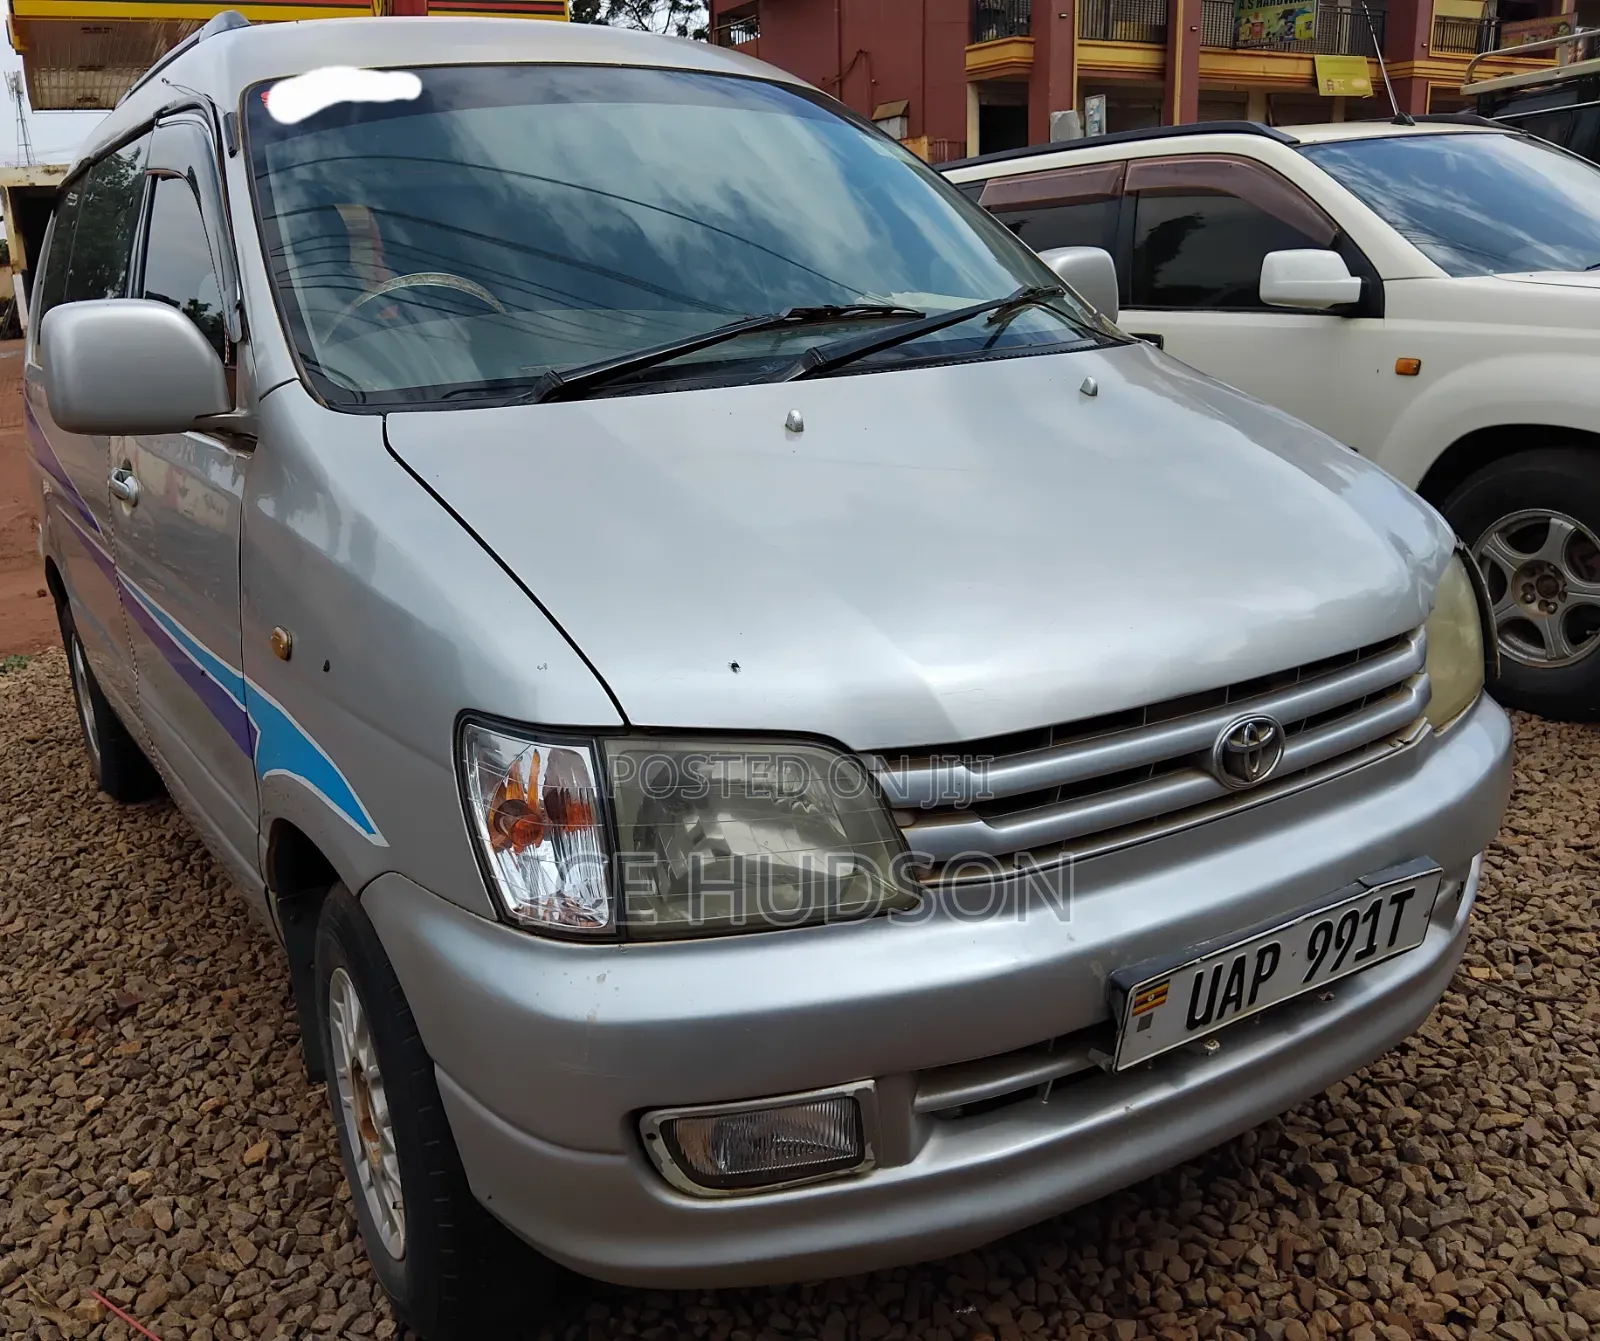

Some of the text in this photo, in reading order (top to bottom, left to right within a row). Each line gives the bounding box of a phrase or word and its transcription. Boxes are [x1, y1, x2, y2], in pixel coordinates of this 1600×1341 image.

[1256, 0, 1313, 8] HARD
[1185, 887, 1416, 1031] UAP 991T
